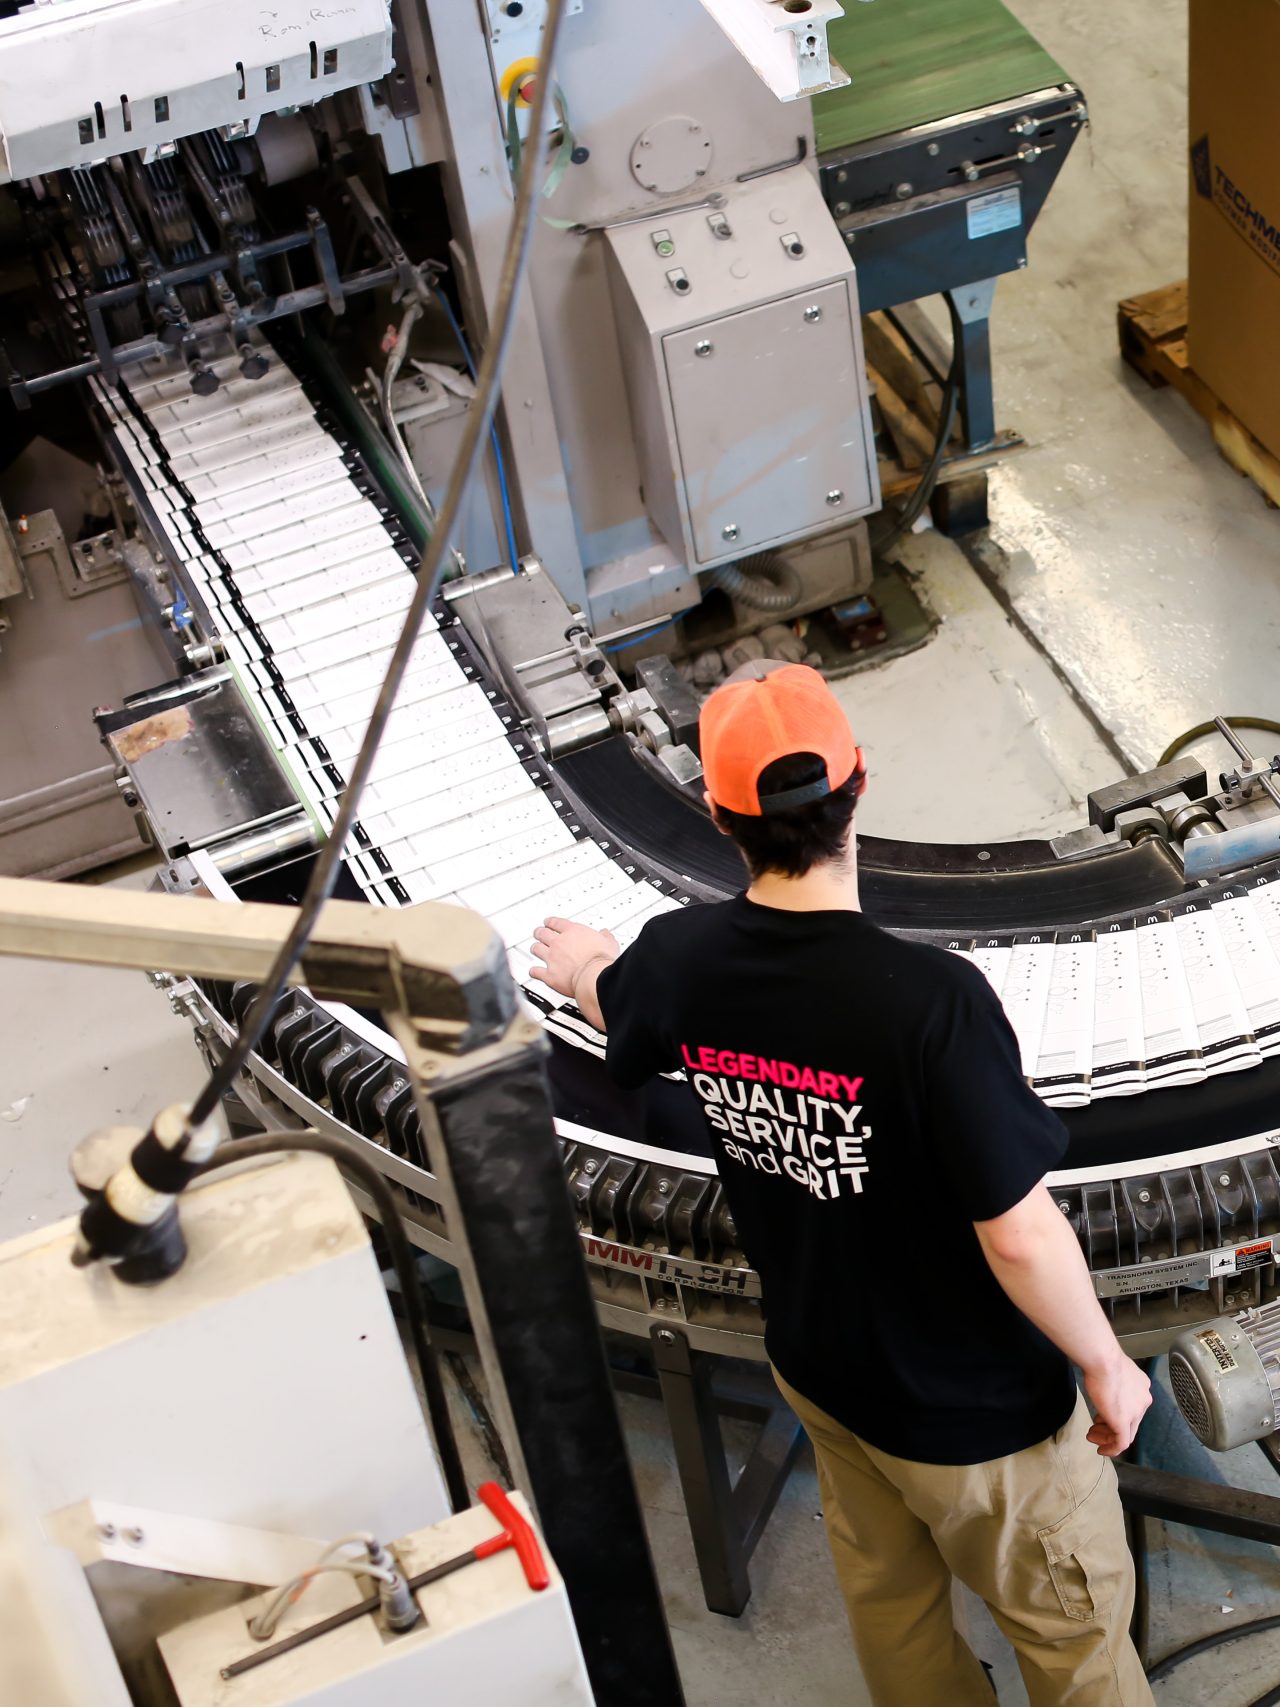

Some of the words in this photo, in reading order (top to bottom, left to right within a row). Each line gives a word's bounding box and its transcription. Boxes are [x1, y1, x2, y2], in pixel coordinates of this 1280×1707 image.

[681, 1044, 865, 1102] LEGENDARY
[693, 1073, 872, 1139] QUALITY,
[704, 1104, 867, 1167] SERVICE
[722, 1138, 782, 1175] and
[783, 1155, 870, 1200] GRIT
[1107, 1269, 1154, 1281] TRANSNORM
[1155, 1264, 1184, 1274] SYSTEM
[1165, 1277, 1189, 1286] TEXAS
